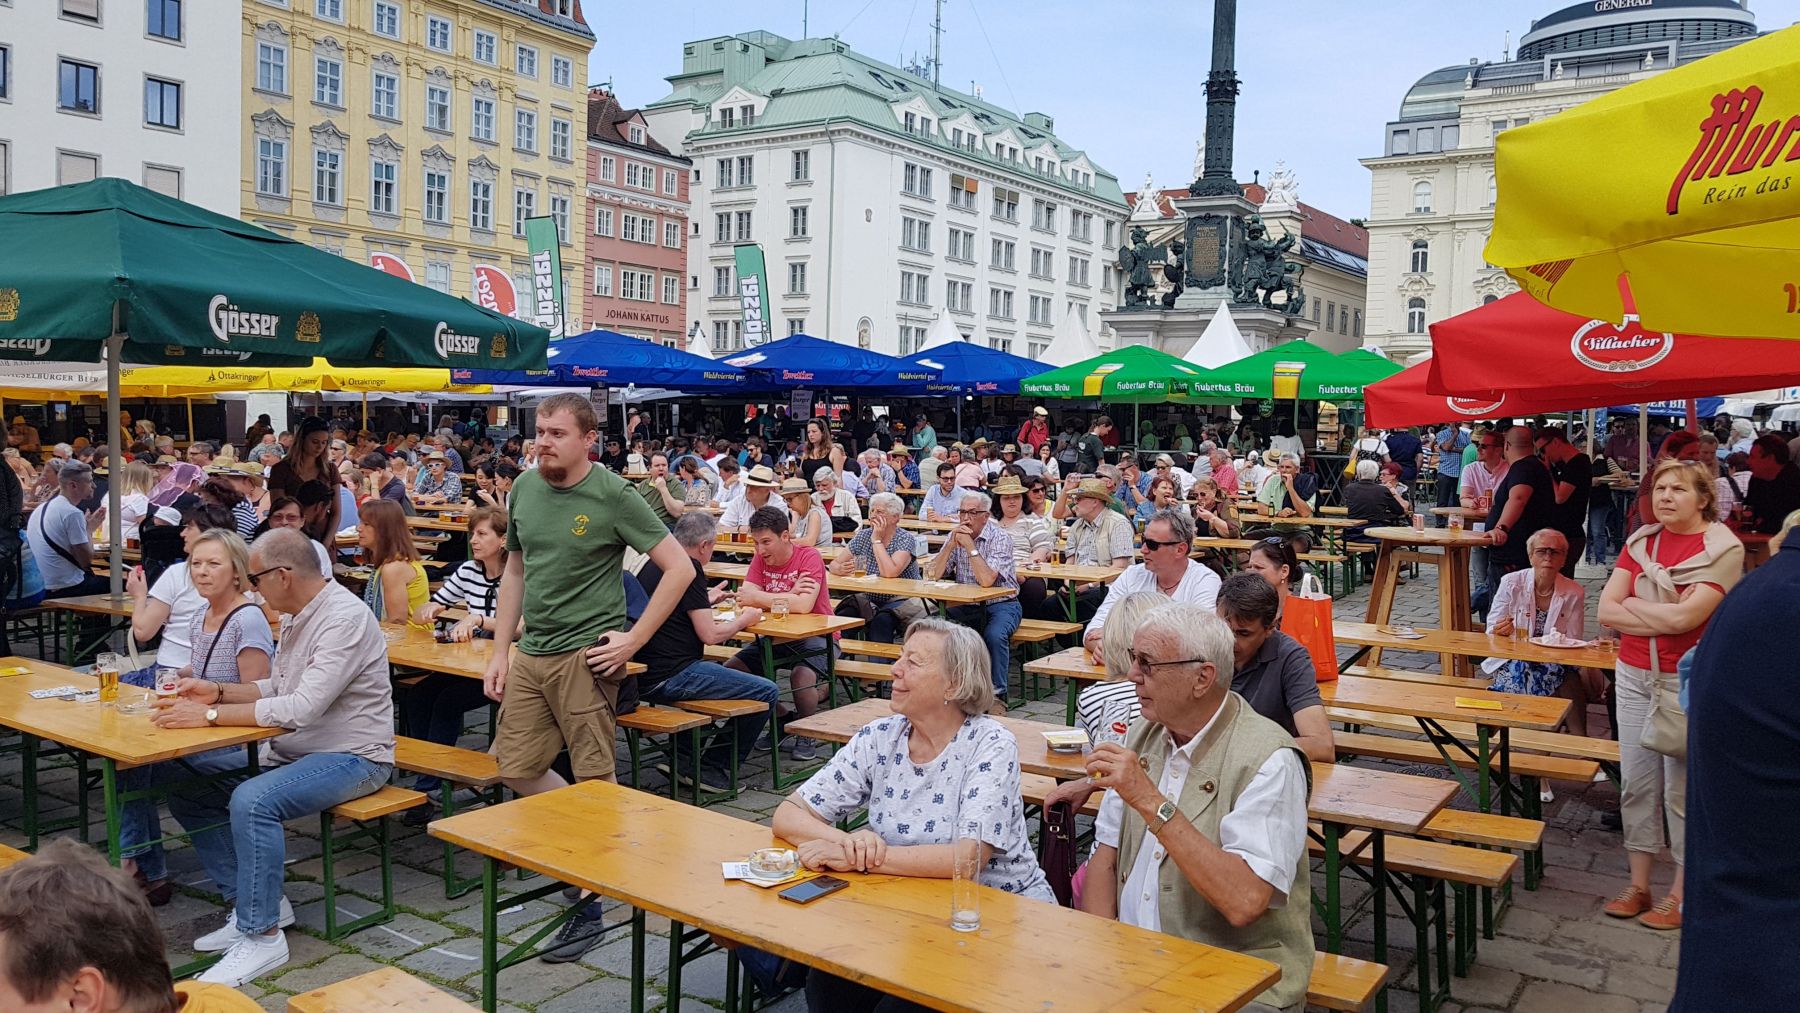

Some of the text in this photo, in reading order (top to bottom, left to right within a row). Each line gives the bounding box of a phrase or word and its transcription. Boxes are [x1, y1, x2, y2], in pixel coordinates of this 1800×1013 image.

[1703, 176, 1792, 205] Rein das
[208, 294, 279, 342] Gösser
[605, 309, 639, 320] JOHANN
[640, 313, 670, 324] KATTUS
[434, 321, 480, 360] Gösser
[1583, 334, 1660, 351] Villacher
[218, 370, 259, 382] Ottakringer
[348, 377, 386, 387] Ottakringer
[1024, 383, 1070, 393] Hubertus Bräu
[1117, 381, 1146, 390] Hubertus
[1148, 380, 1164, 389] Bräu
[1194, 382, 1232, 392] Hubertus
[1234, 383, 1255, 393] Bräu
[1318, 384, 1358, 394] Hubertus
